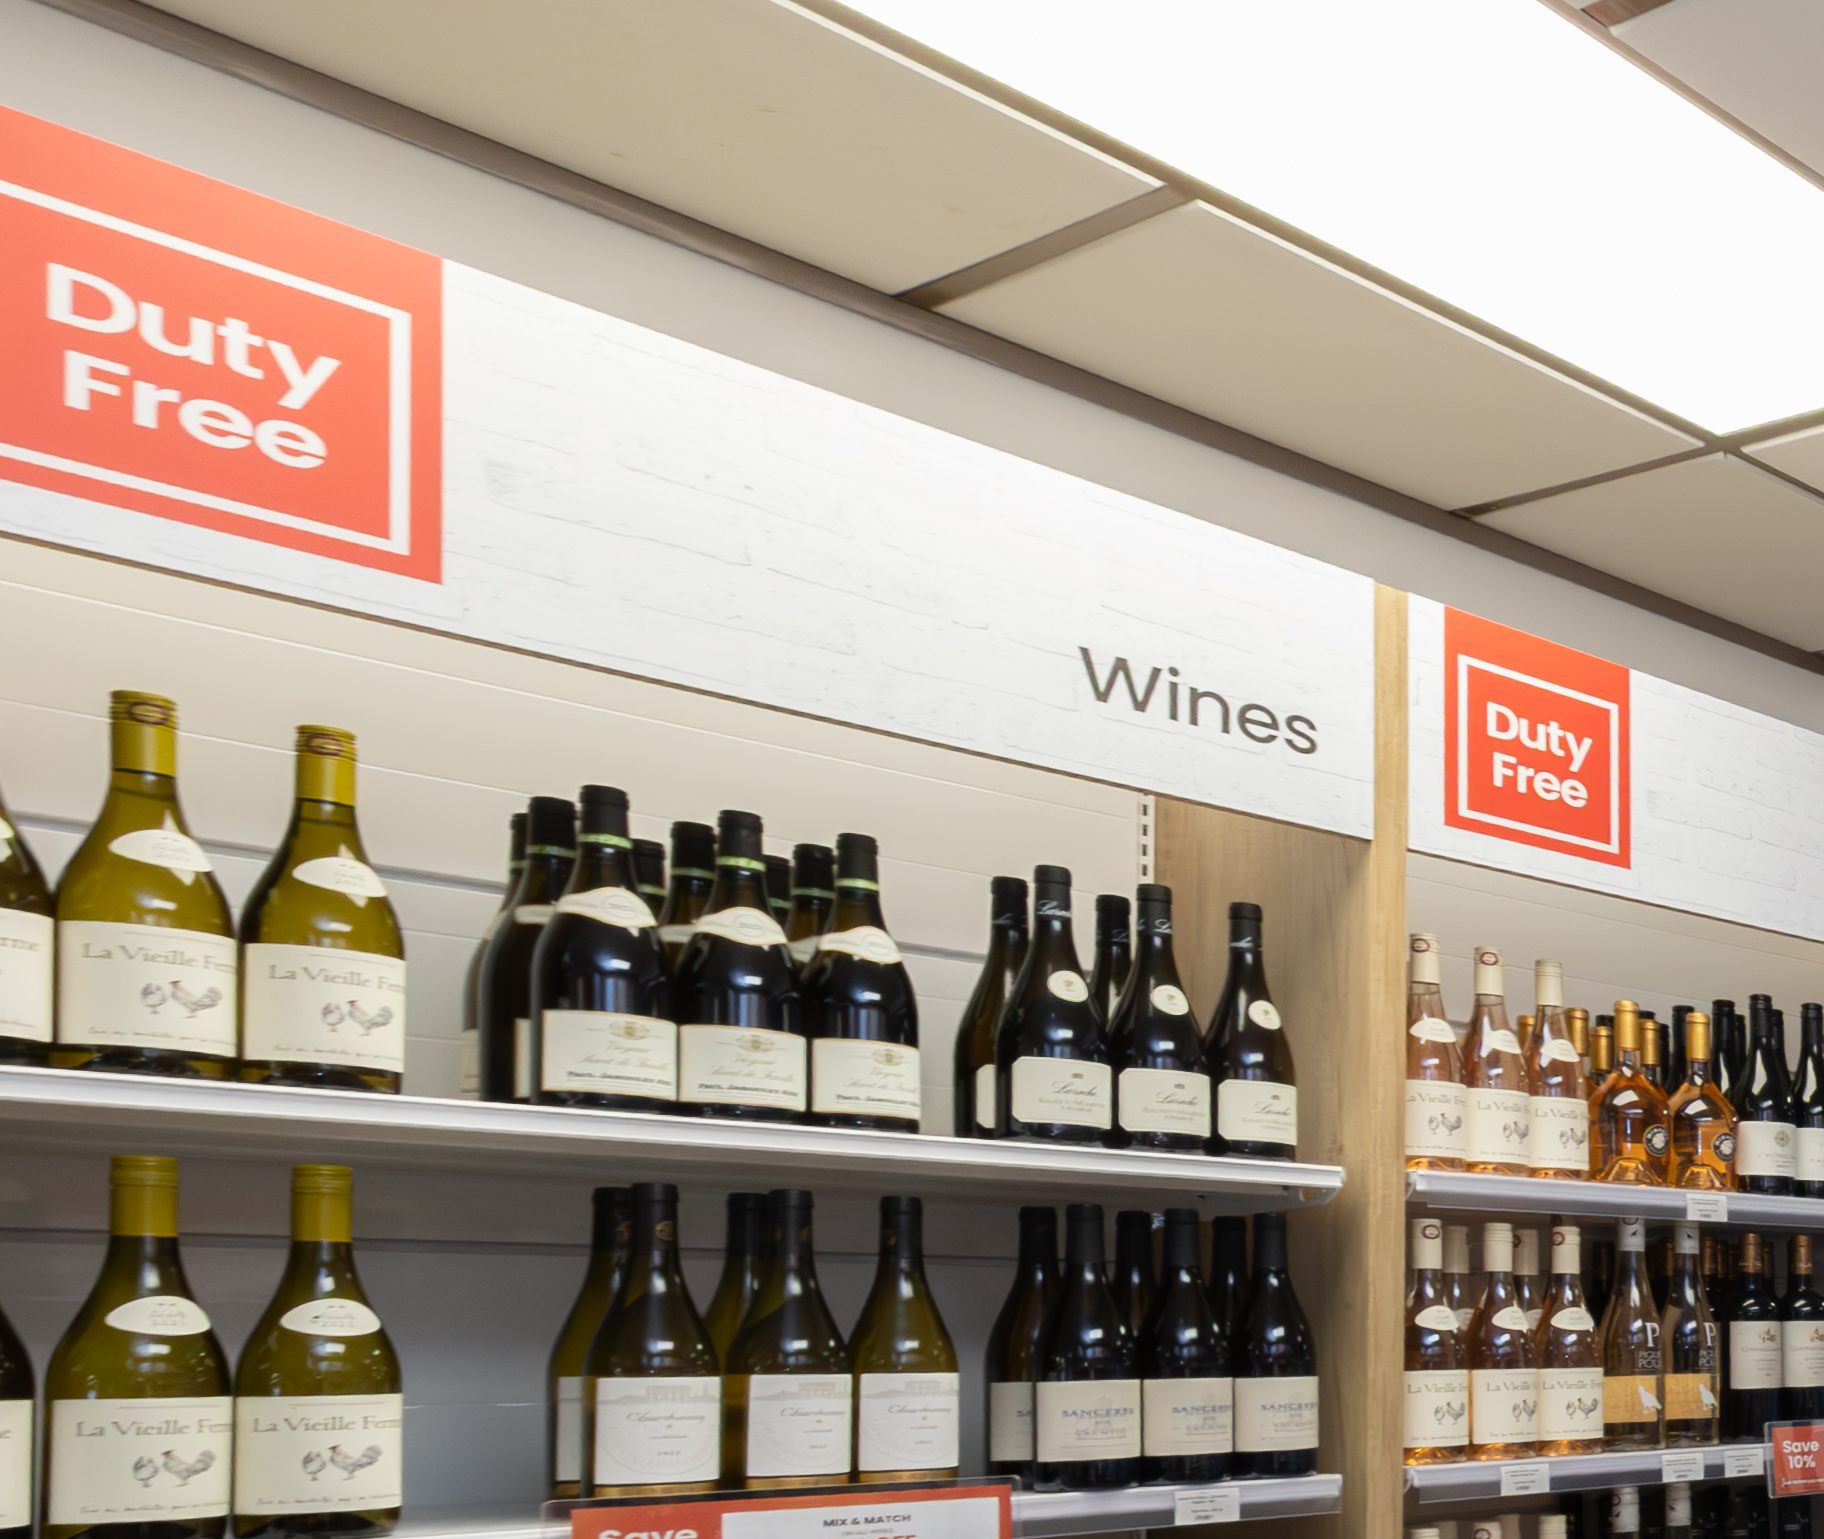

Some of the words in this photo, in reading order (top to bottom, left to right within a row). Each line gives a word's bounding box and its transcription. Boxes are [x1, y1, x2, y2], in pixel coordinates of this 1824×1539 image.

[46, 262, 341, 410] Duty
[64, 350, 327, 469] Free
[1078, 645, 1319, 755] Wines
[1486, 700, 1592, 773] Duty
[1492, 751, 1588, 809] Free
[82, 942, 113, 961] La
[116, 944, 199, 970] Vieille
[269, 965, 298, 982] La
[301, 966, 372, 988] Vieille
[76, 1421, 108, 1438] La
[110, 1417, 192, 1437] Vieille
[252, 1417, 279, 1433] La
[282, 1416, 357, 1432] Vieille
[1782, 1440, 1820, 1453] Save
[1788, 1455, 1816, 1469] 10%
[823, 1518, 848, 1528] MIX
[864, 1513, 912, 1525] MATCH
